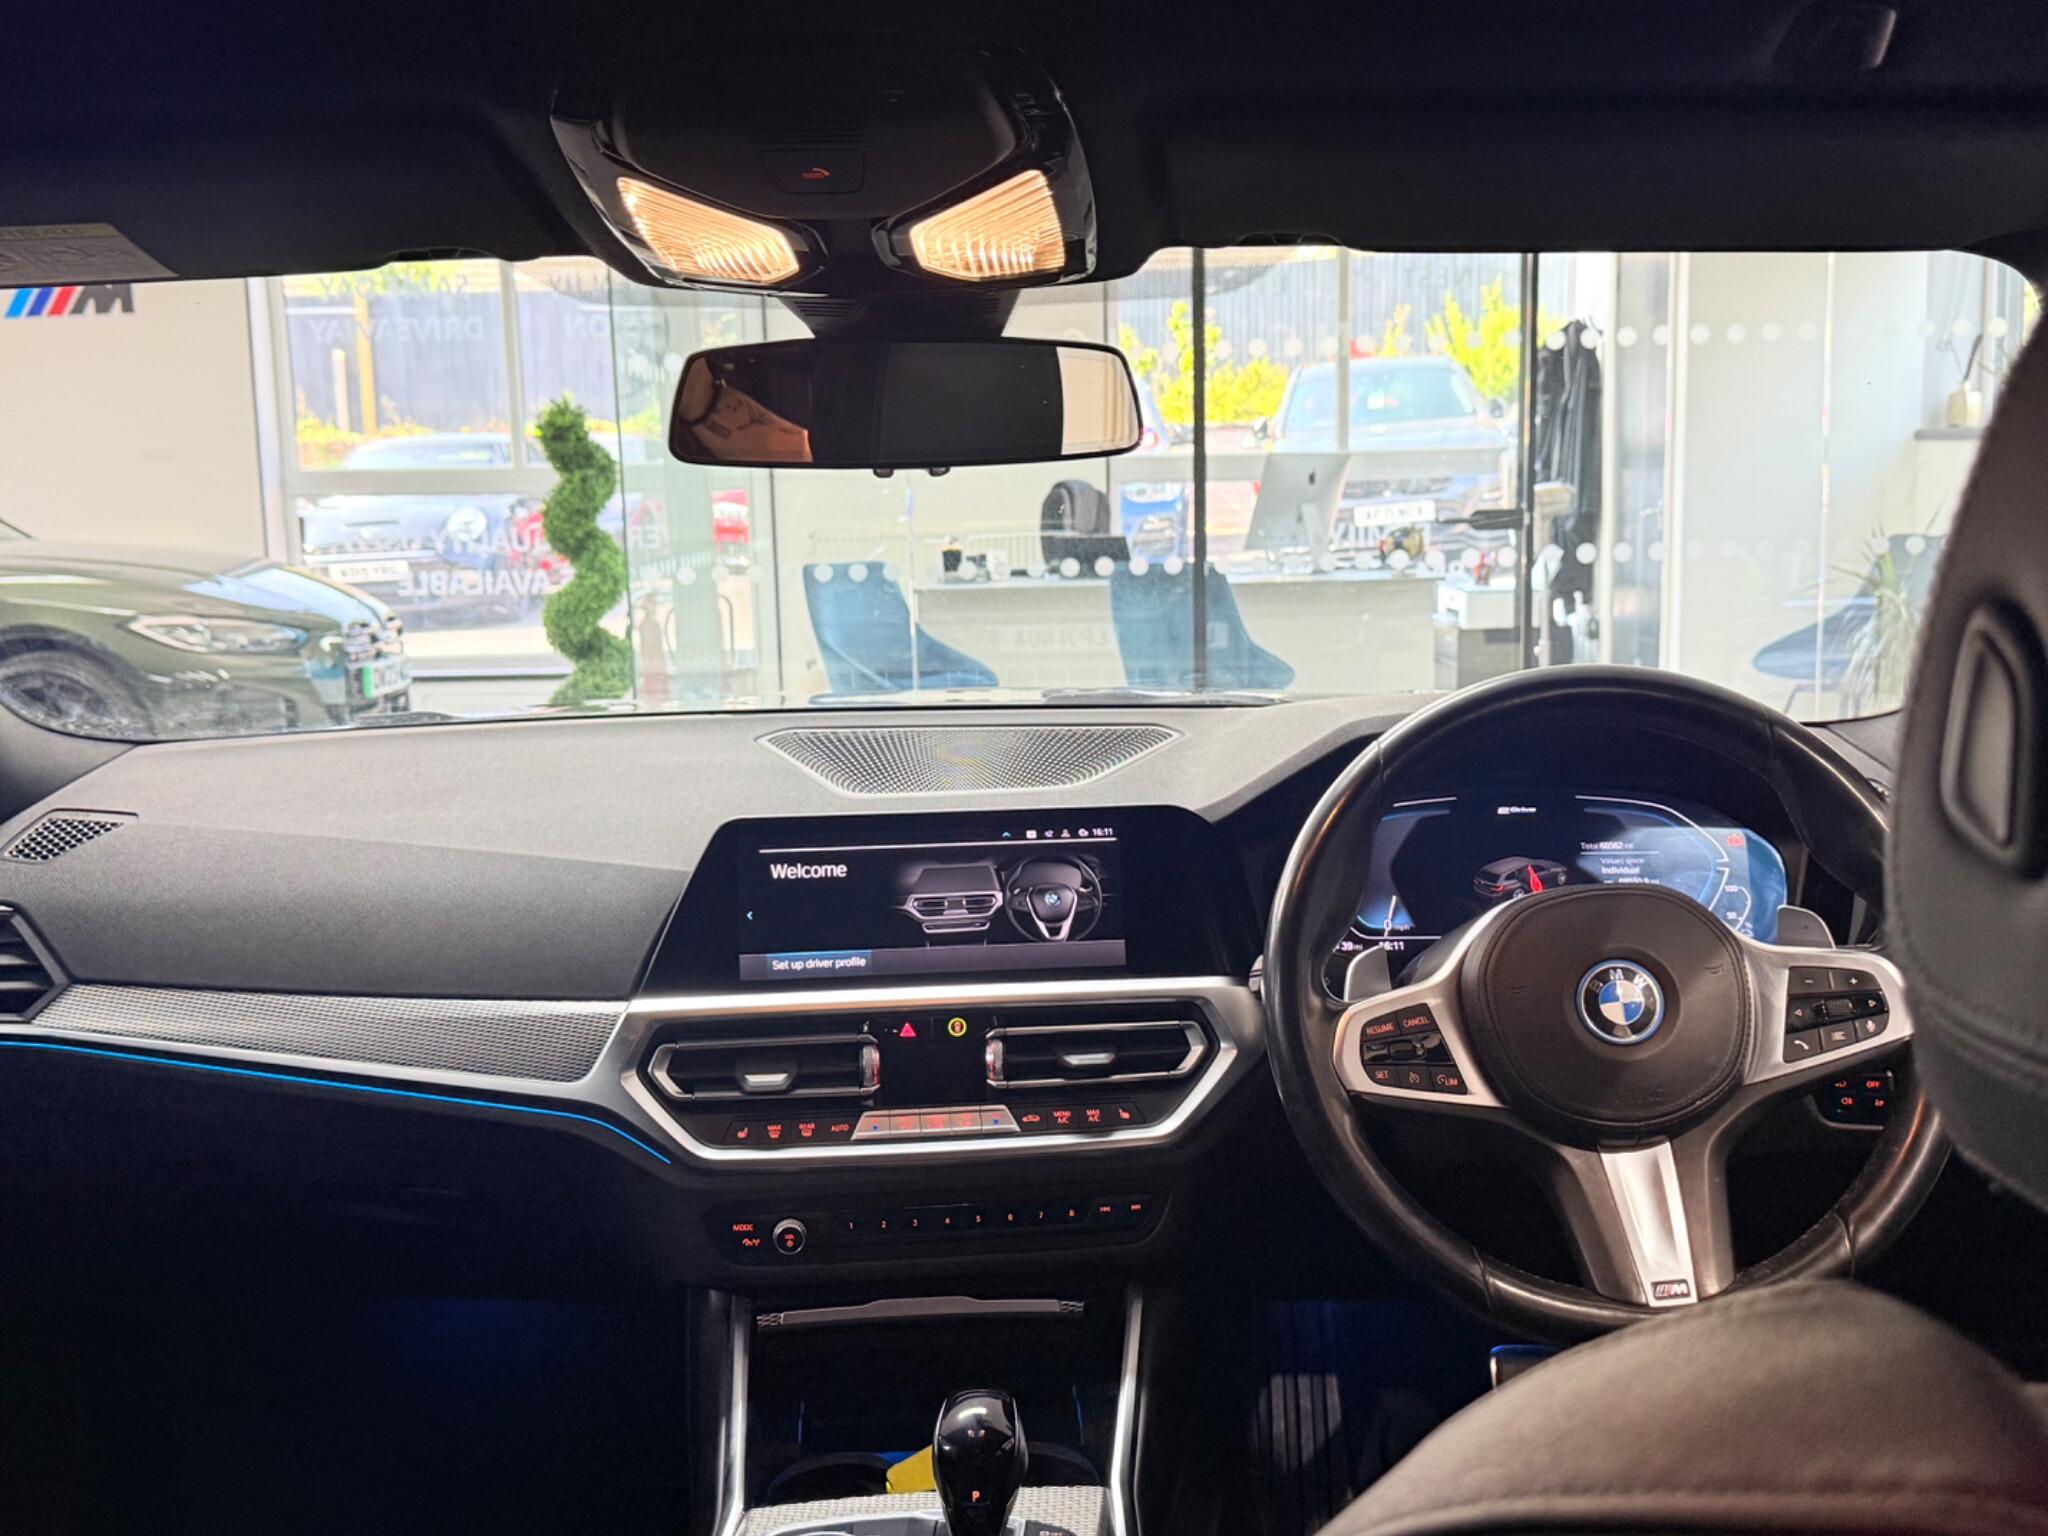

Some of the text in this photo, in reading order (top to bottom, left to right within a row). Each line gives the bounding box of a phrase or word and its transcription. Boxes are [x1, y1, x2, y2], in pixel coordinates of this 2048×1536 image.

[1092, 827, 1114, 837] 16:11
[769, 863, 848, 880] Welcome
[1601, 865, 1640, 875] Individual
[772, 956, 867, 971] Set up driver profile
[1366, 1022, 1394, 1036] RESUME
[1403, 1016, 1431, 1029] CANCEL
[1375, 1070, 1389, 1080] SET
[971, 1490, 981, 1504] P
